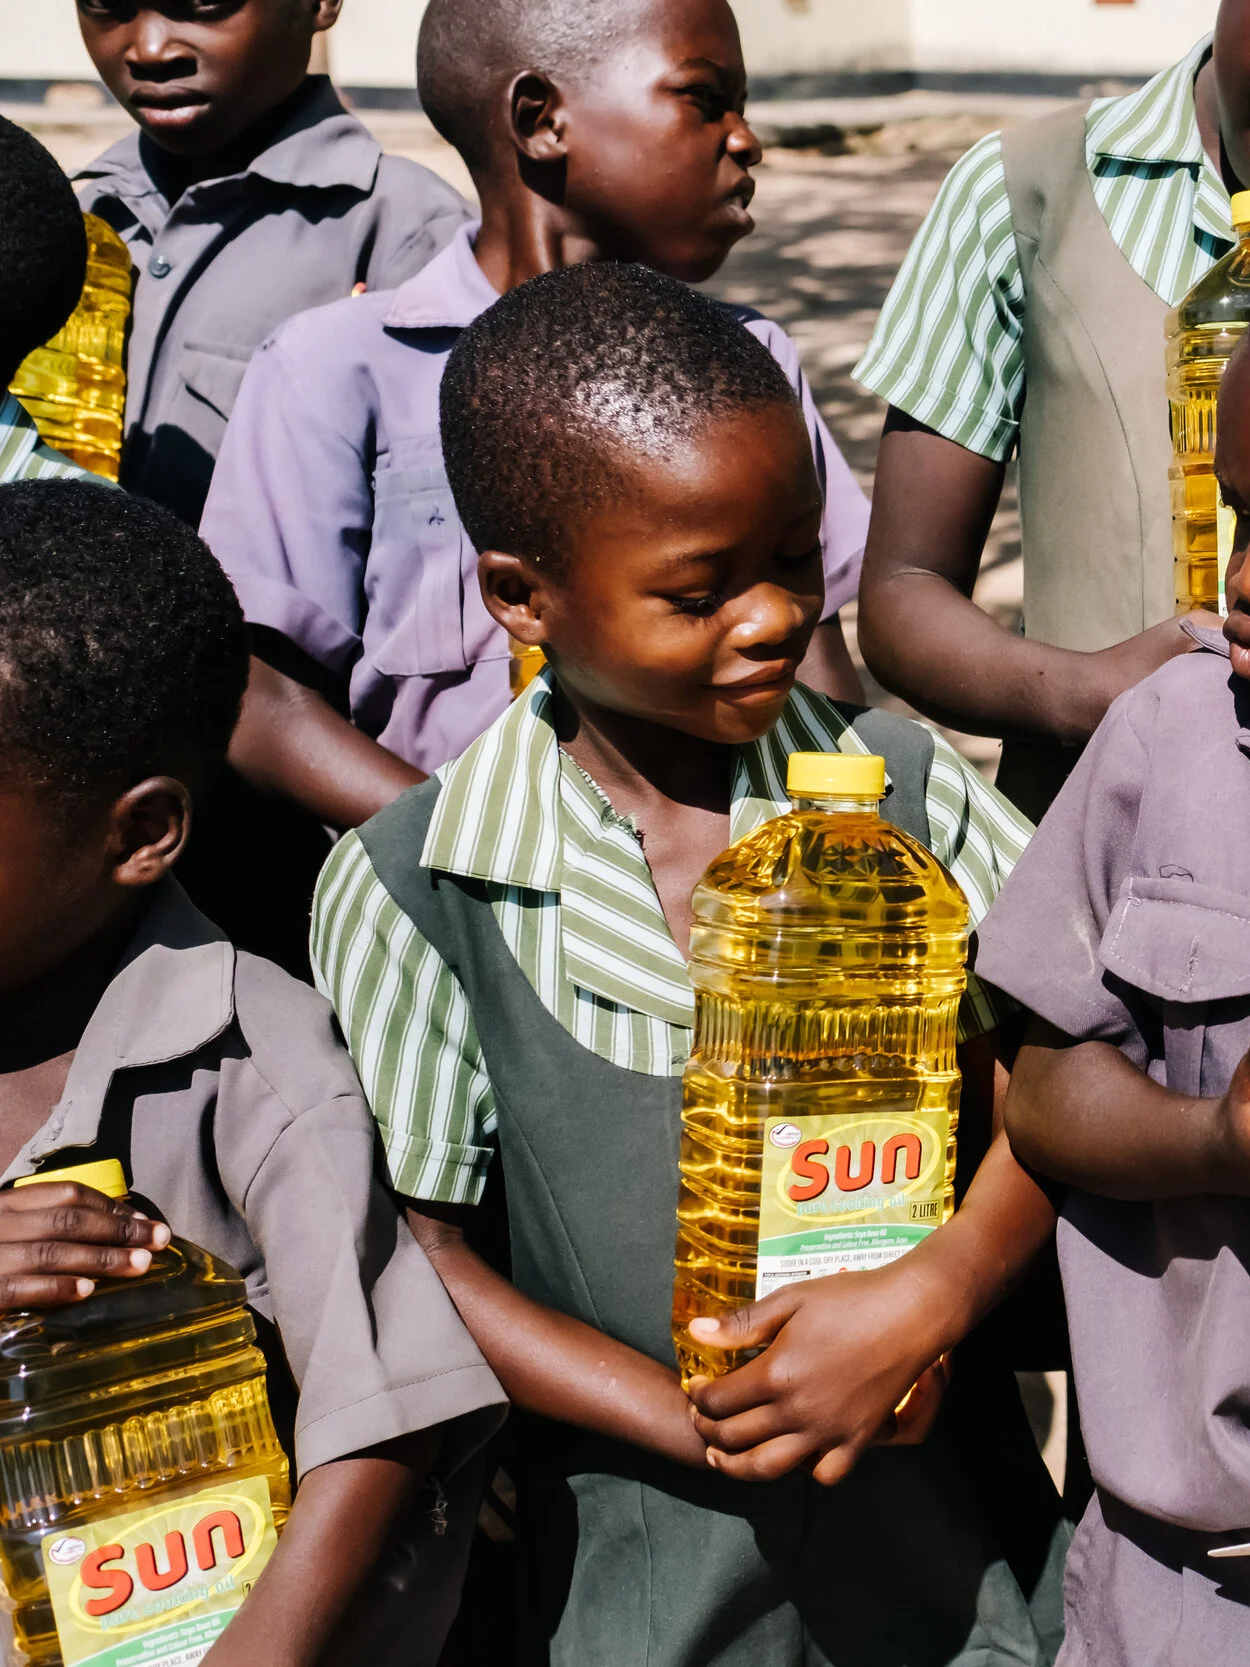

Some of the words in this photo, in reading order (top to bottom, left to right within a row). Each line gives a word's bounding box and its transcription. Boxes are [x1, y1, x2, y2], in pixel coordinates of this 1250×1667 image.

[796, 1202, 827, 1216] pure
[831, 1194, 883, 1210] cooking
[887, 1193, 905, 1207] oil
[911, 1205, 918, 1218] 2
[919, 1202, 938, 1217] LITRE
[780, 1258, 797, 1268] STORE
[798, 1257, 804, 1266] IN
[808, 1256, 821, 1265] COOL
[823, 1255, 834, 1264] DRY
[853, 1252, 867, 1261] AWAY
[867, 1251, 882, 1260] FROM
[883, 1249, 901, 1258] DIRECT
[100, 1608, 139, 1630] pure
[143, 1585, 209, 1616] cooking
[215, 1575, 235, 1592] oil
[185, 1650, 202, 1662] AWAY
